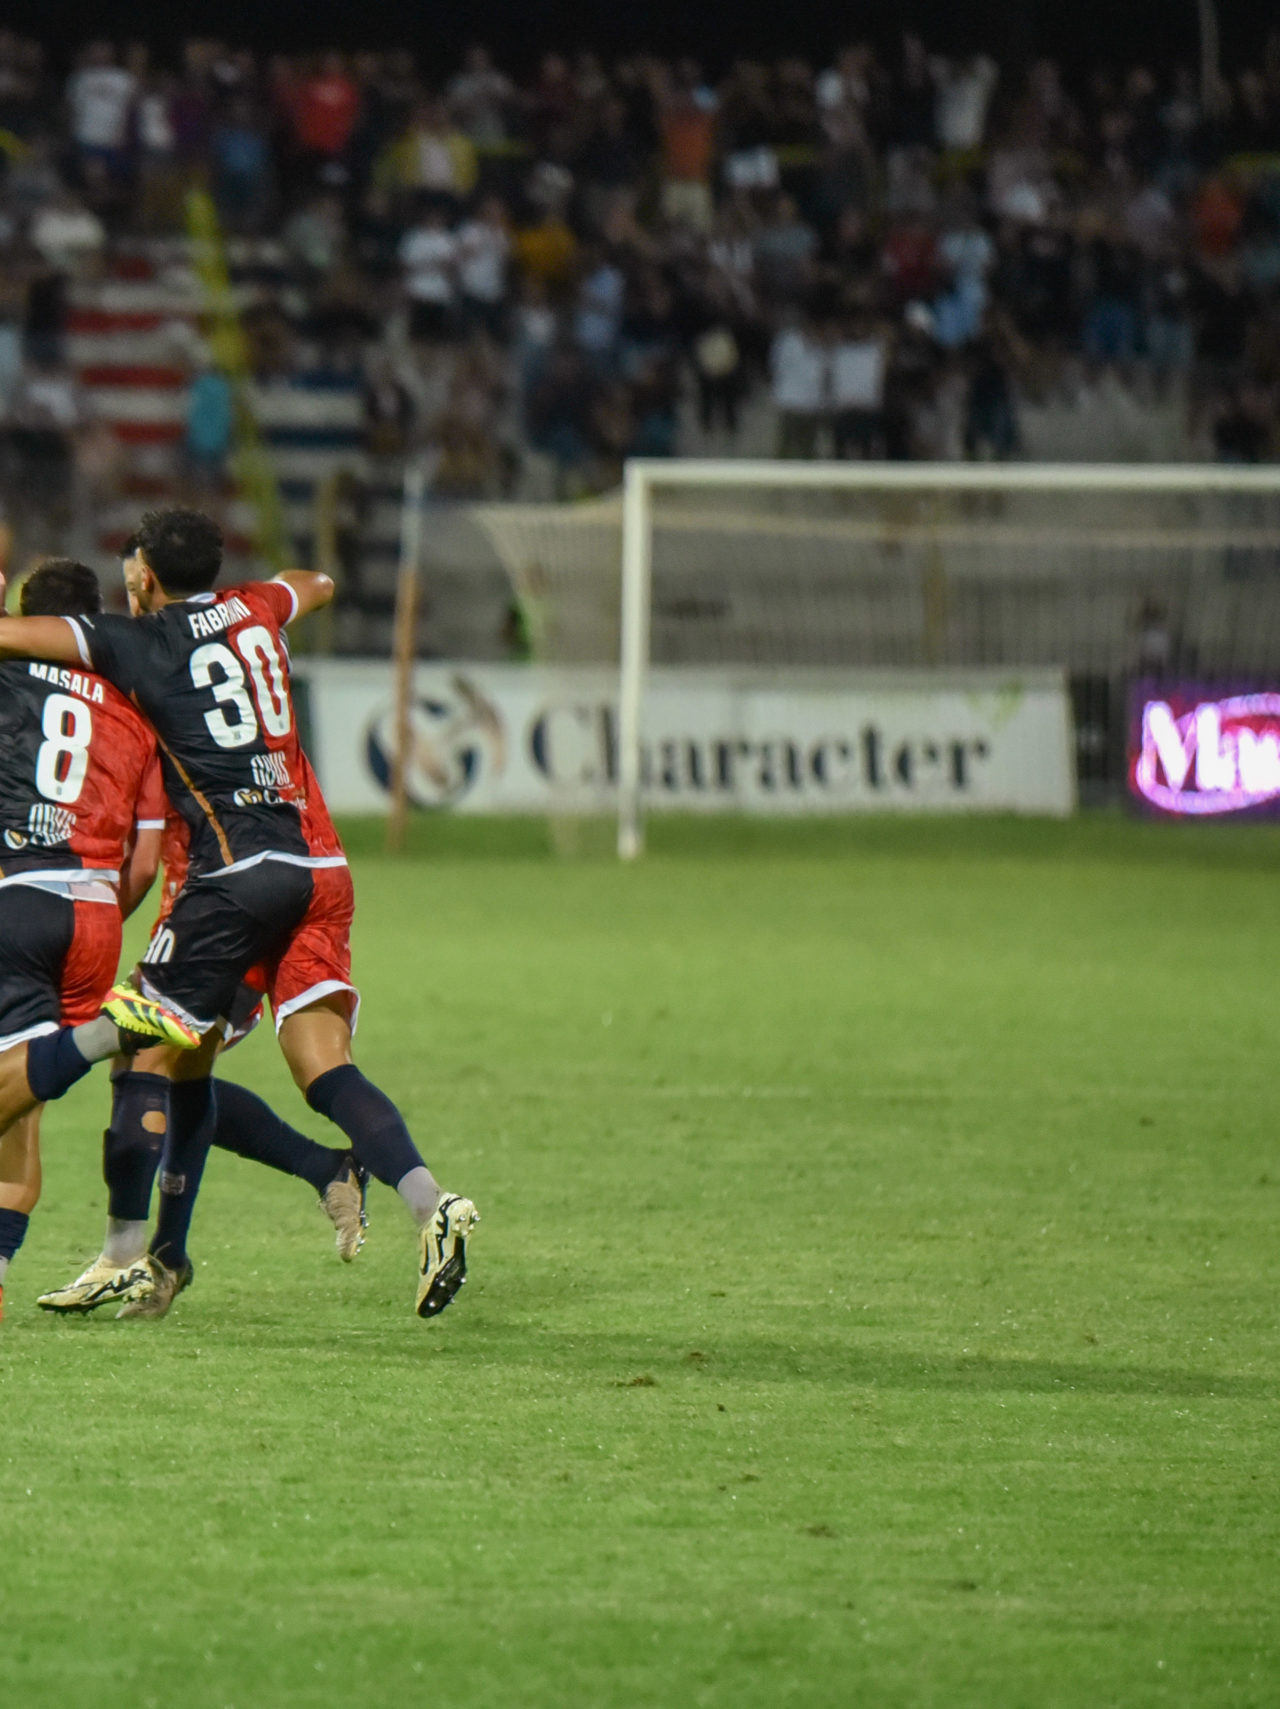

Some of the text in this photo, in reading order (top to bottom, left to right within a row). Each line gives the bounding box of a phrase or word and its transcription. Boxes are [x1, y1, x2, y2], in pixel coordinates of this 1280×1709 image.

[29, 662, 104, 704] MASALA
[189, 625, 291, 748] 30
[35, 692, 92, 803] 8
[527, 702, 988, 792] Character
